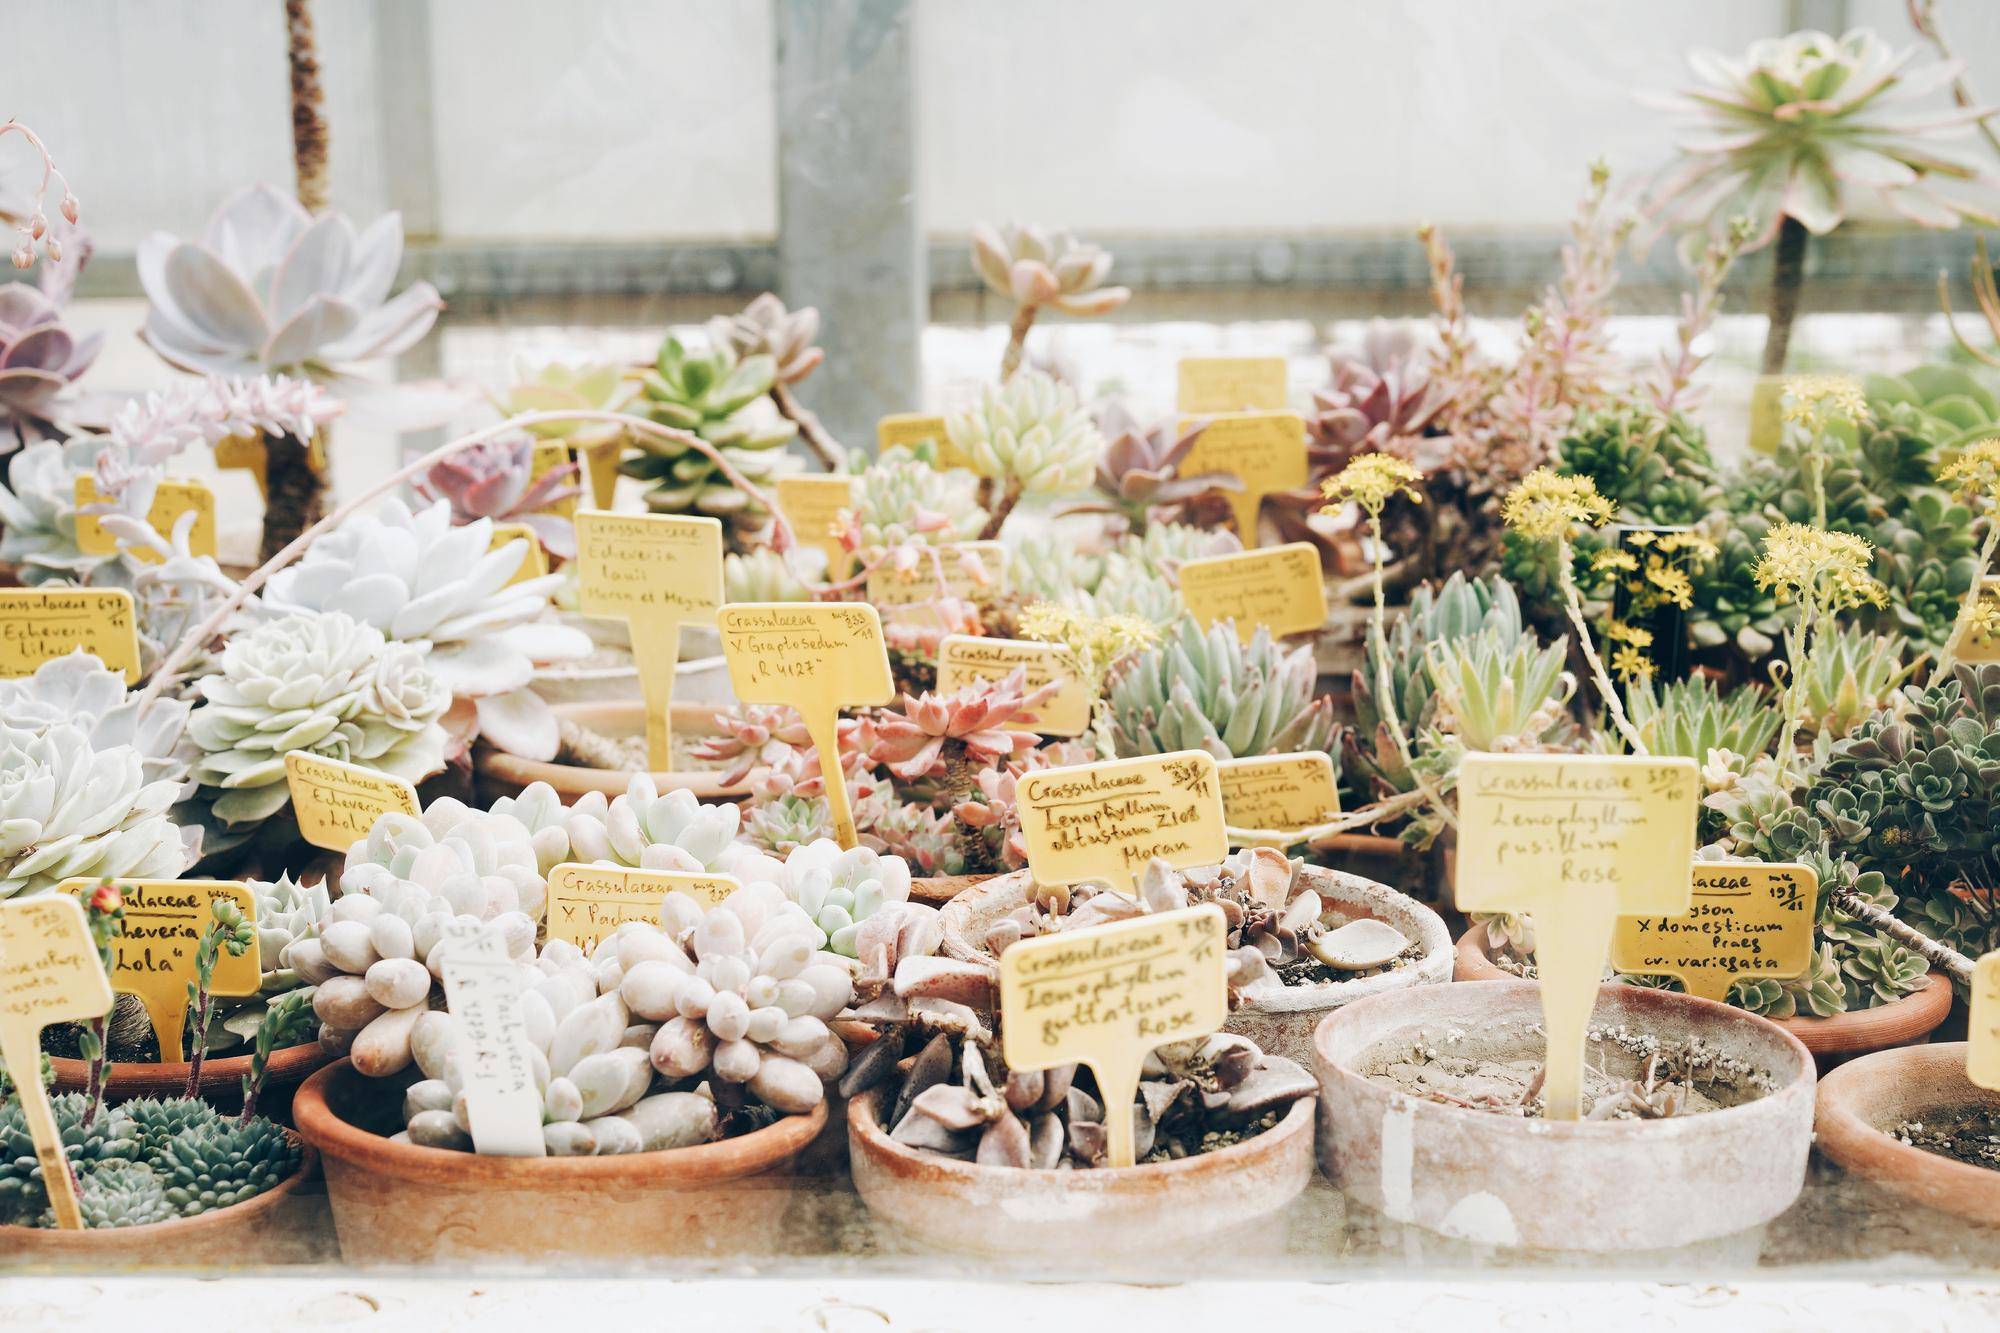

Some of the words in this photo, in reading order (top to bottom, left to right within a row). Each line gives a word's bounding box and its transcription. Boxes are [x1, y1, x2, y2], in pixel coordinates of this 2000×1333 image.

[1028, 771, 1147, 802] Crassulaceae
[1475, 765, 1635, 793] Crassulaceae
[1560, 858, 1623, 884] Rose
[1657, 916, 1784, 935] domesticum
[1677, 955, 1779, 973] variegata
